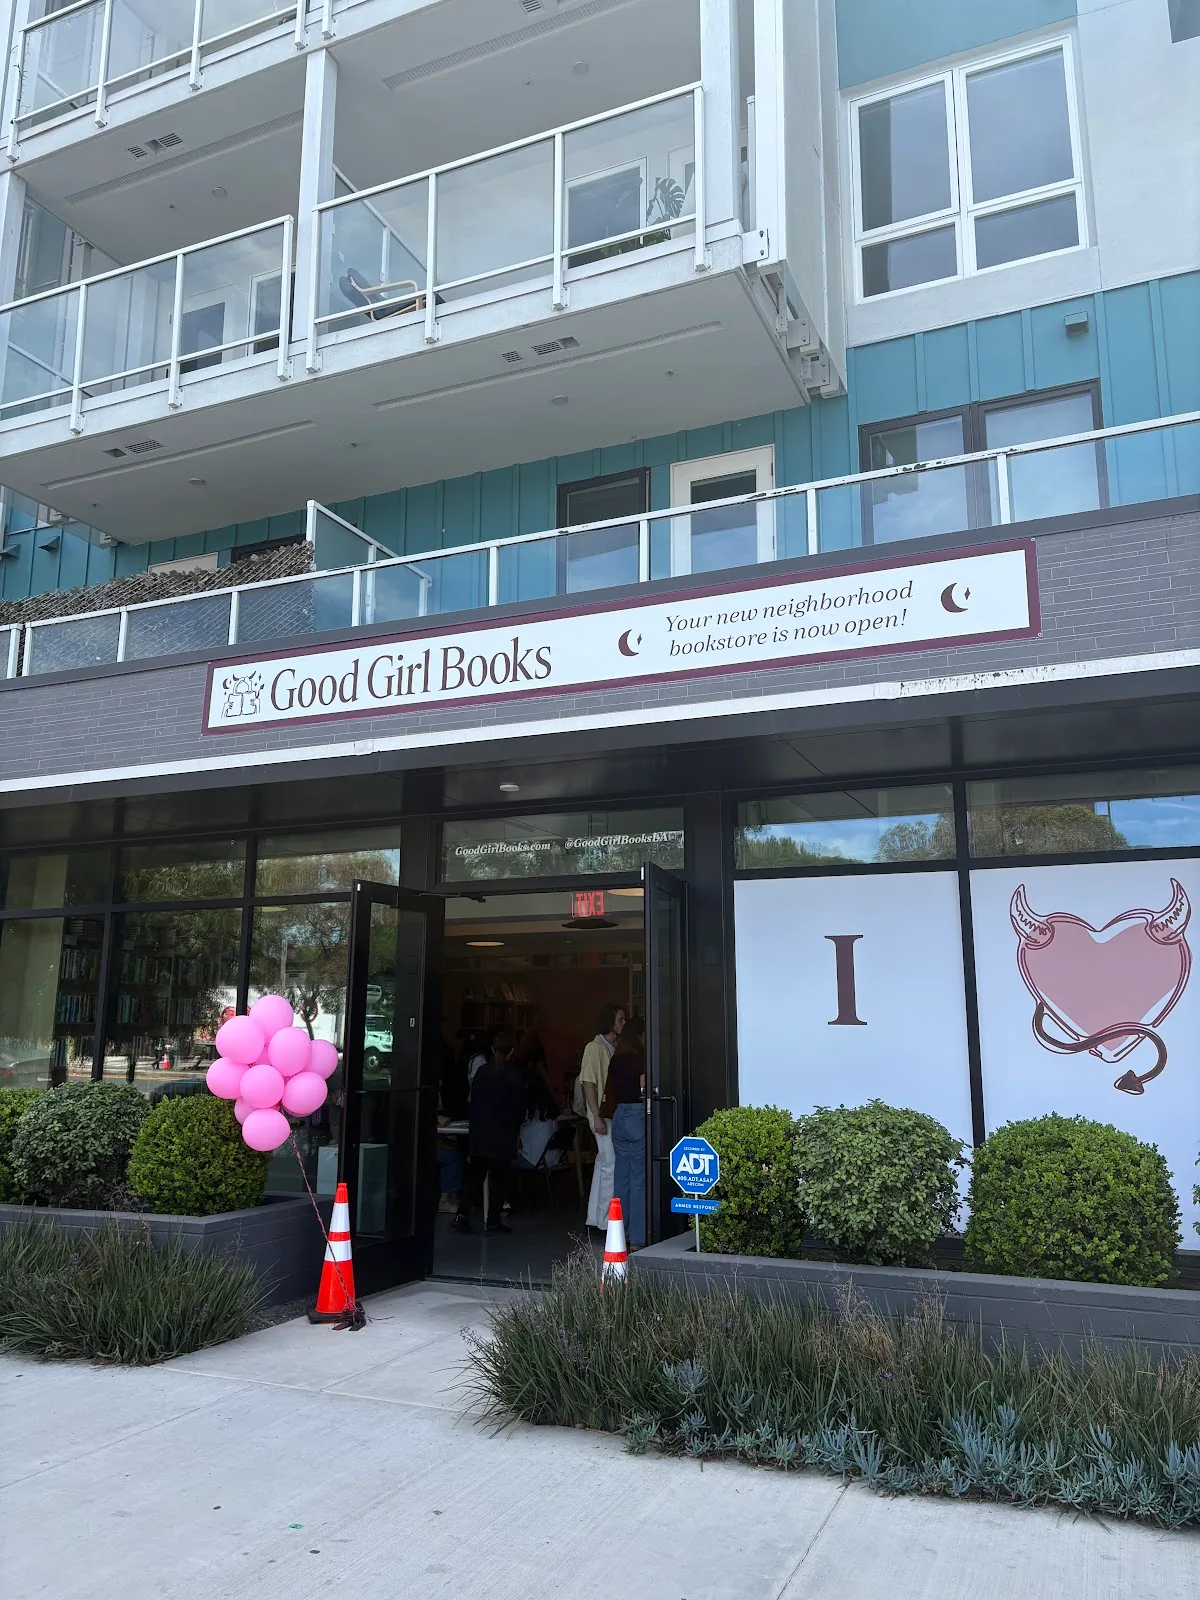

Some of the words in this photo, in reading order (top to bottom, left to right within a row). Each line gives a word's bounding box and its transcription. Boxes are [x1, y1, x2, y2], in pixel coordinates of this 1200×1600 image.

[666, 614, 713, 633] Your
[716, 607, 759, 627] new
[762, 580, 914, 618] neighborhood
[669, 631, 767, 657] bookstore
[771, 626, 789, 644] is
[793, 621, 840, 641] now
[843, 608, 908, 637] open!
[270, 658, 360, 712] Good
[366, 648, 431, 700] Girl
[439, 636, 553, 692] Books
[455, 842, 551, 856] GoodGirlBooks.com
[824, 934, 868, 1027] I
[675, 1153, 714, 1176] ADT
